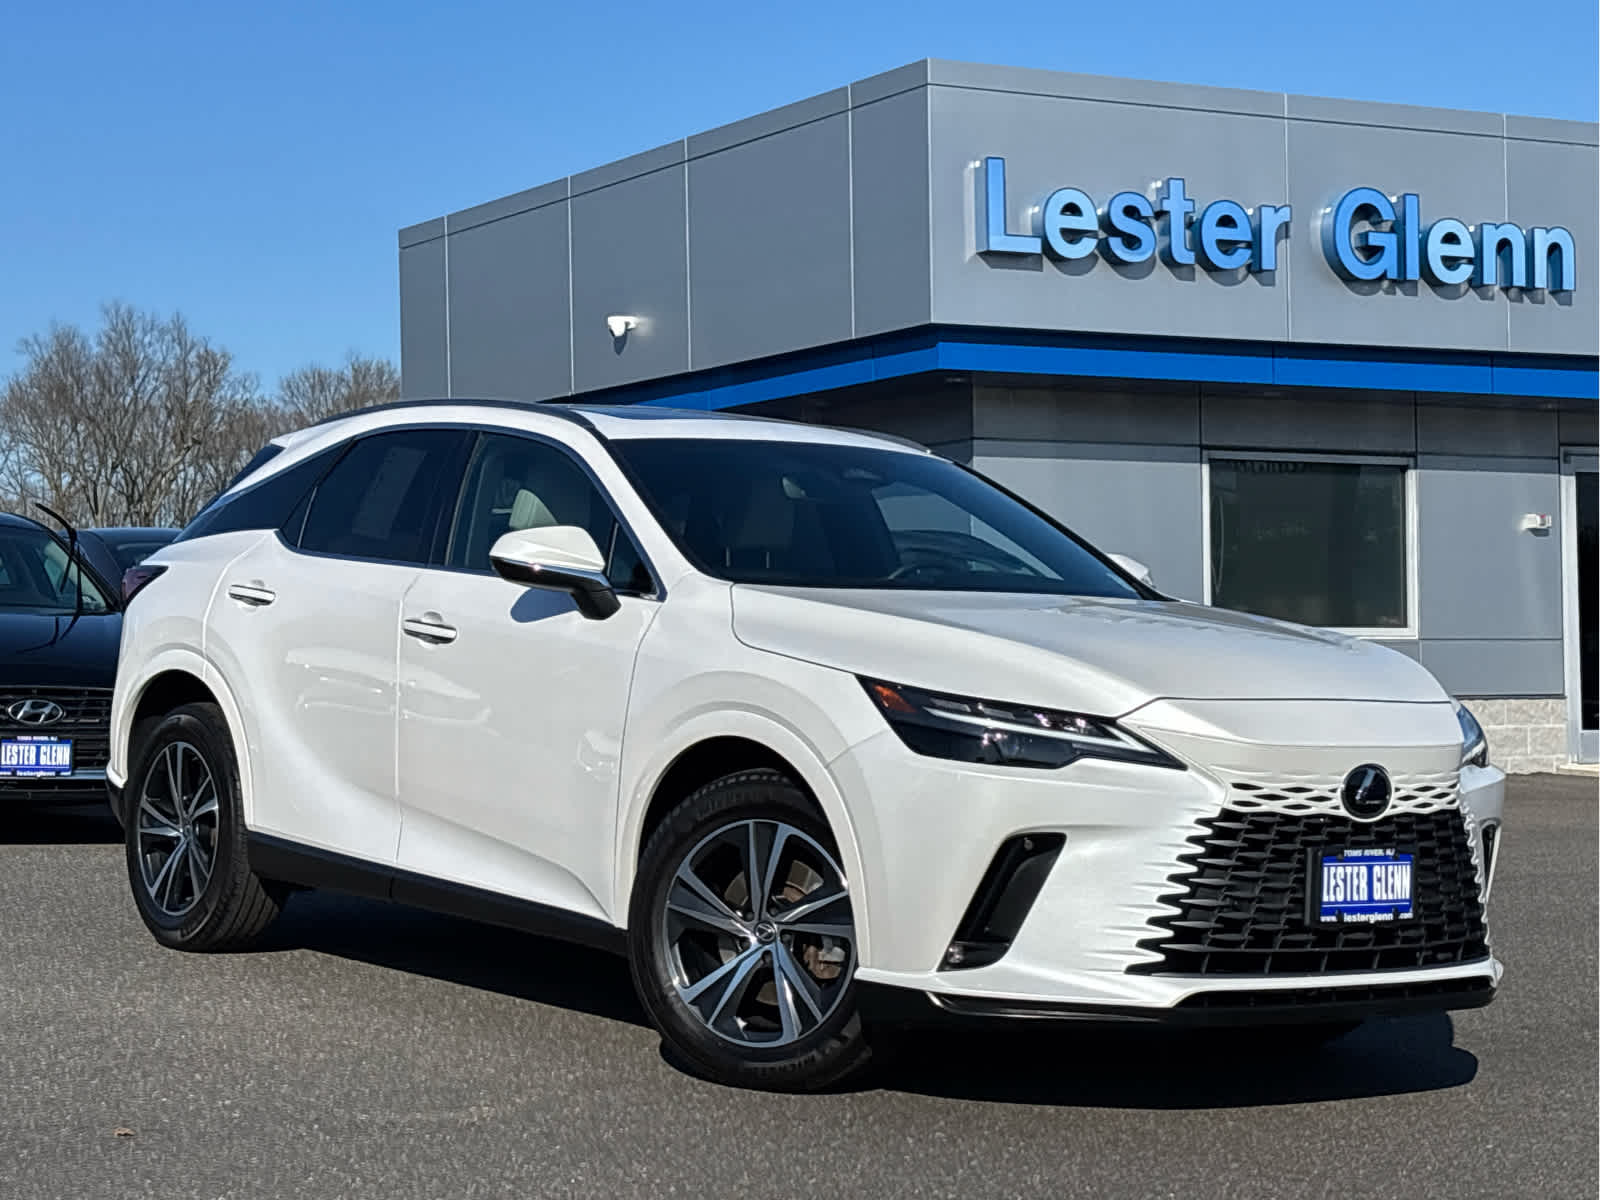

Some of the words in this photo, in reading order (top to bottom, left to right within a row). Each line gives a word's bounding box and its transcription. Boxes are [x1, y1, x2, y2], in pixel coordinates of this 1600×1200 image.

[978, 157, 1290, 272] Lester
[1323, 187, 1574, 292] Glenn
[1, 745, 36, 766] LESTER
[40, 745, 70, 766] GLENN
[1323, 866, 1367, 902] LESTER
[1373, 865, 1410, 900] GLENN
[1343, 913, 1393, 924] lesterglenn
